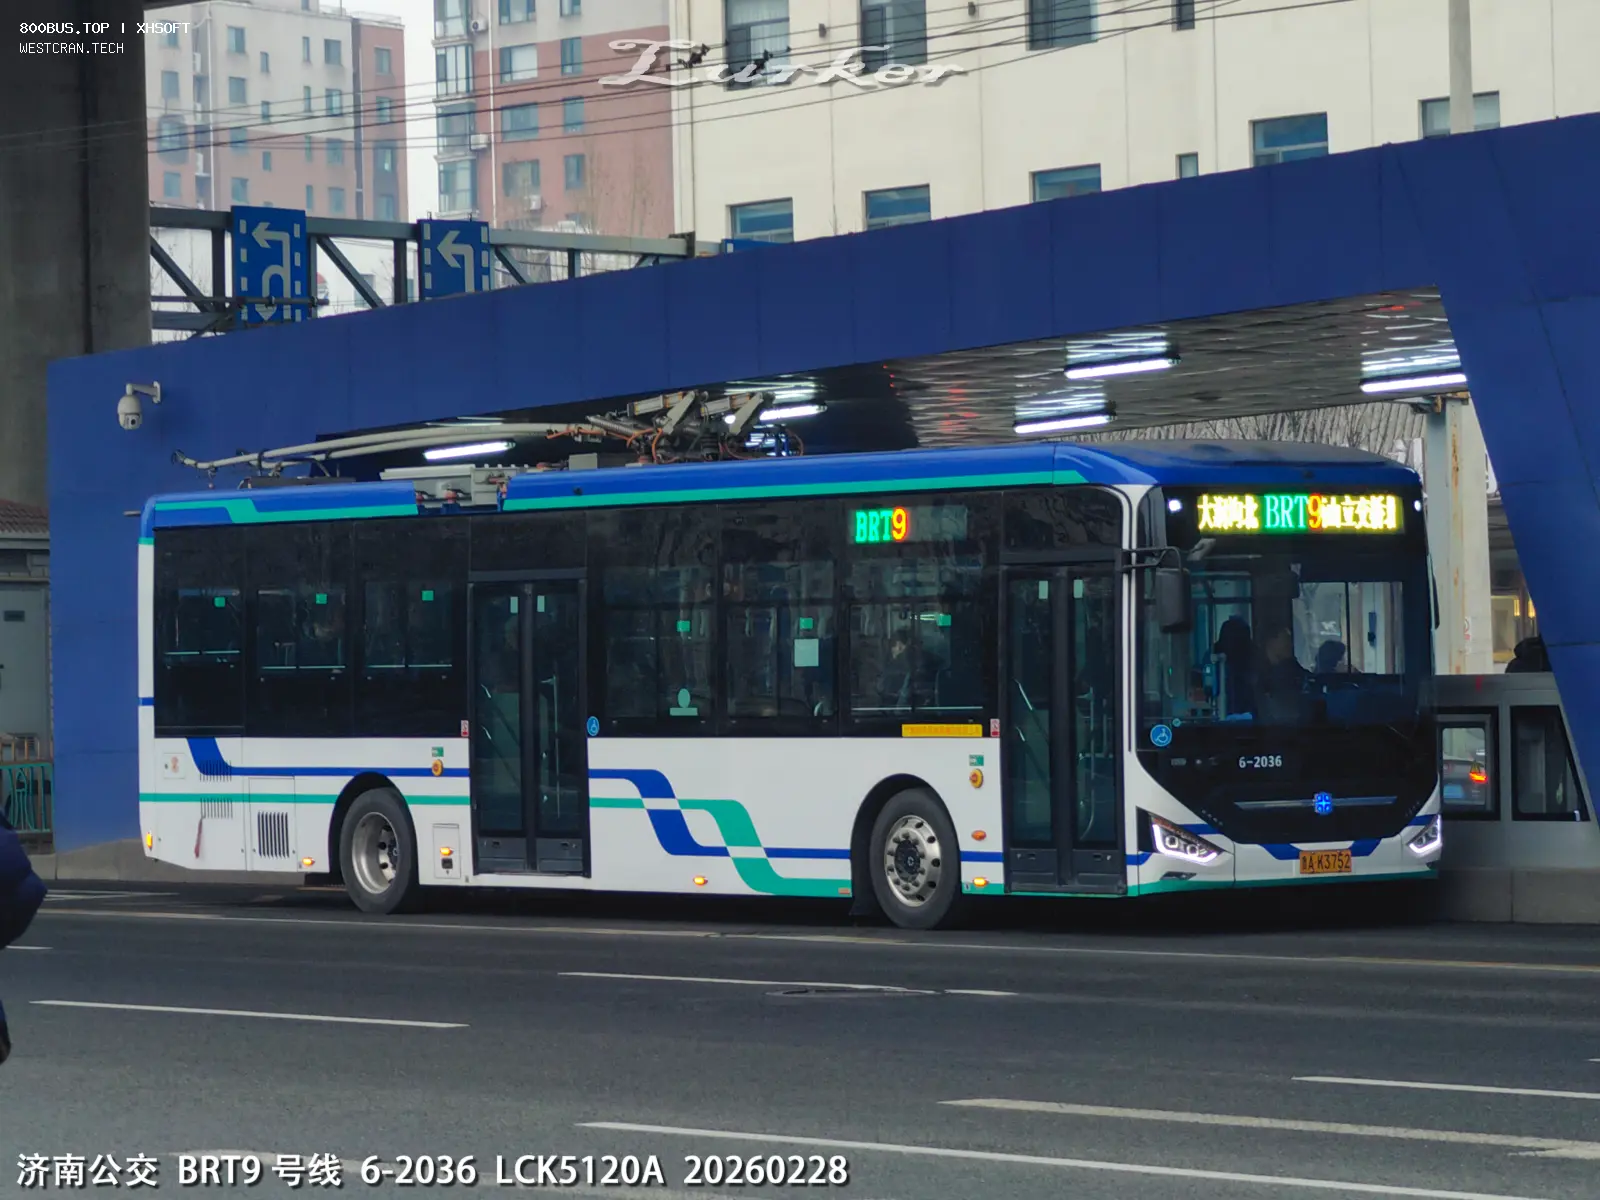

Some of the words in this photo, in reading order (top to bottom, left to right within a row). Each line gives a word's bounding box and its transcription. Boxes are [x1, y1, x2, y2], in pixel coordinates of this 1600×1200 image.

[855, 507, 909, 543] BRT9
[1264, 493, 1322, 530] BRT9
[1238, 755, 1283, 769] 6-2036
